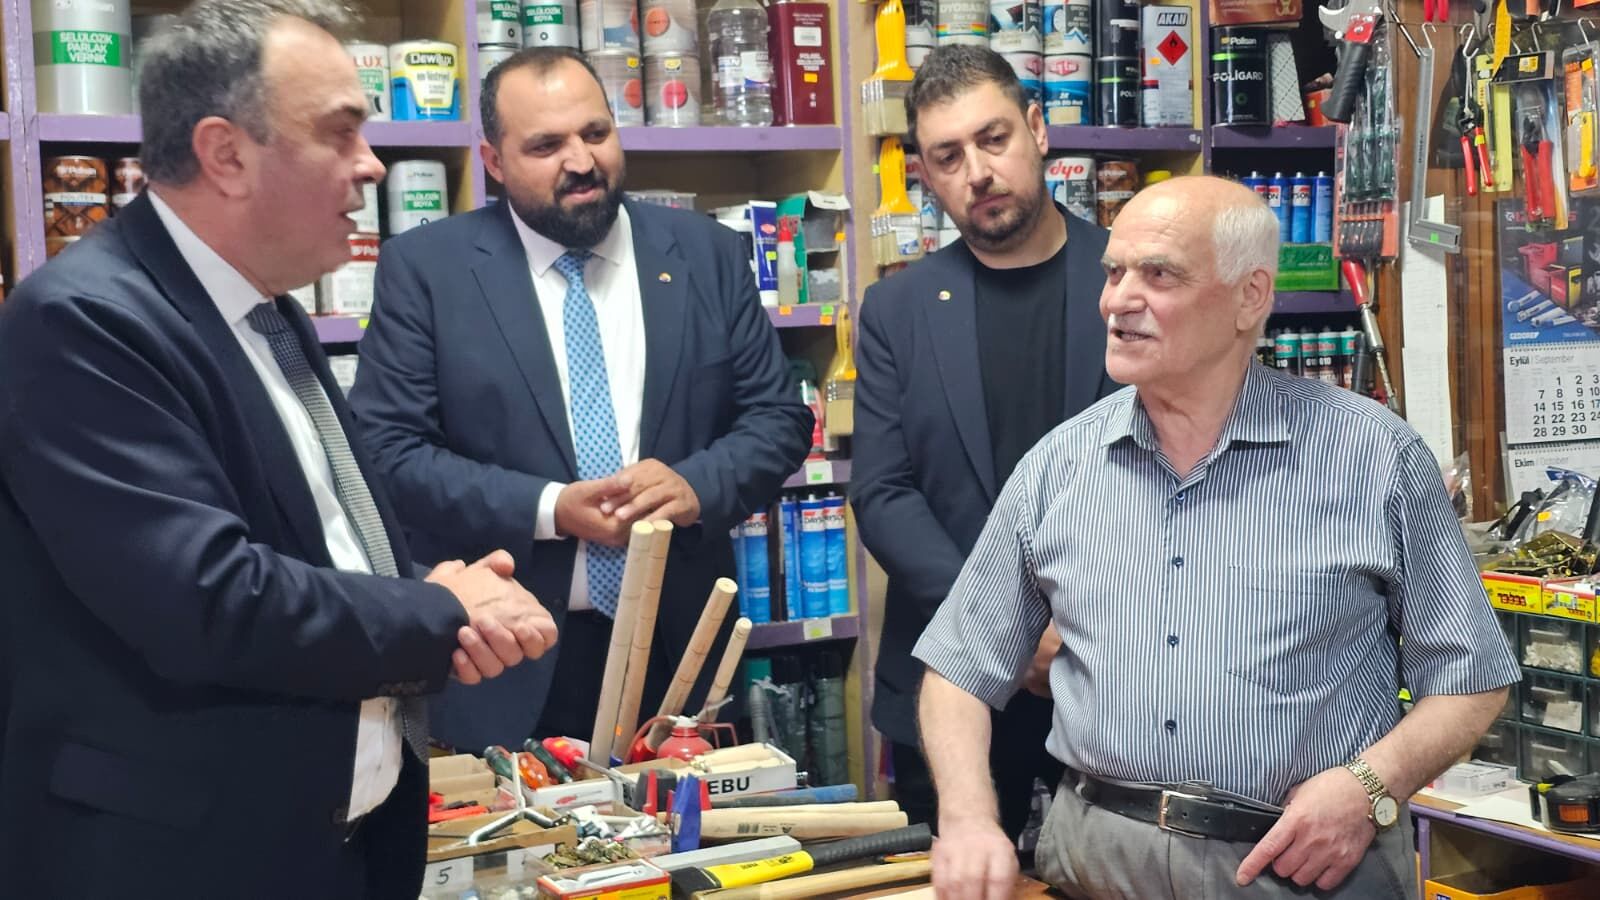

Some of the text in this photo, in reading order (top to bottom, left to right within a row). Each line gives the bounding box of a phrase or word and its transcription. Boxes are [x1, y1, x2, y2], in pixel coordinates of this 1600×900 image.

[1157, 13, 1187, 25] AKAN
[1230, 36, 1257, 45] Polisan
[66, 42, 108, 53] PARLAK
[1049, 161, 1085, 179] dyo
[1510, 354, 1574, 367] Eylül September
[1556, 376, 1561, 386] 1
[1575, 374, 1582, 385] 2
[1593, 374, 1599, 384] 3
[1538, 387, 1600, 399] 7 8 9 10
[1534, 402, 1546, 412] 14
[1552, 401, 1564, 411] 15
[1571, 400, 1585, 410] 16
[1533, 415, 1546, 425] 21
[1551, 414, 1566, 424] 22
[1571, 412, 1585, 422] 23
[1533, 424, 1587, 437] 28 29 30
[1514, 458, 1535, 468] Ekim
[708, 776, 751, 794] EBU
[436, 866, 453, 885] 5
